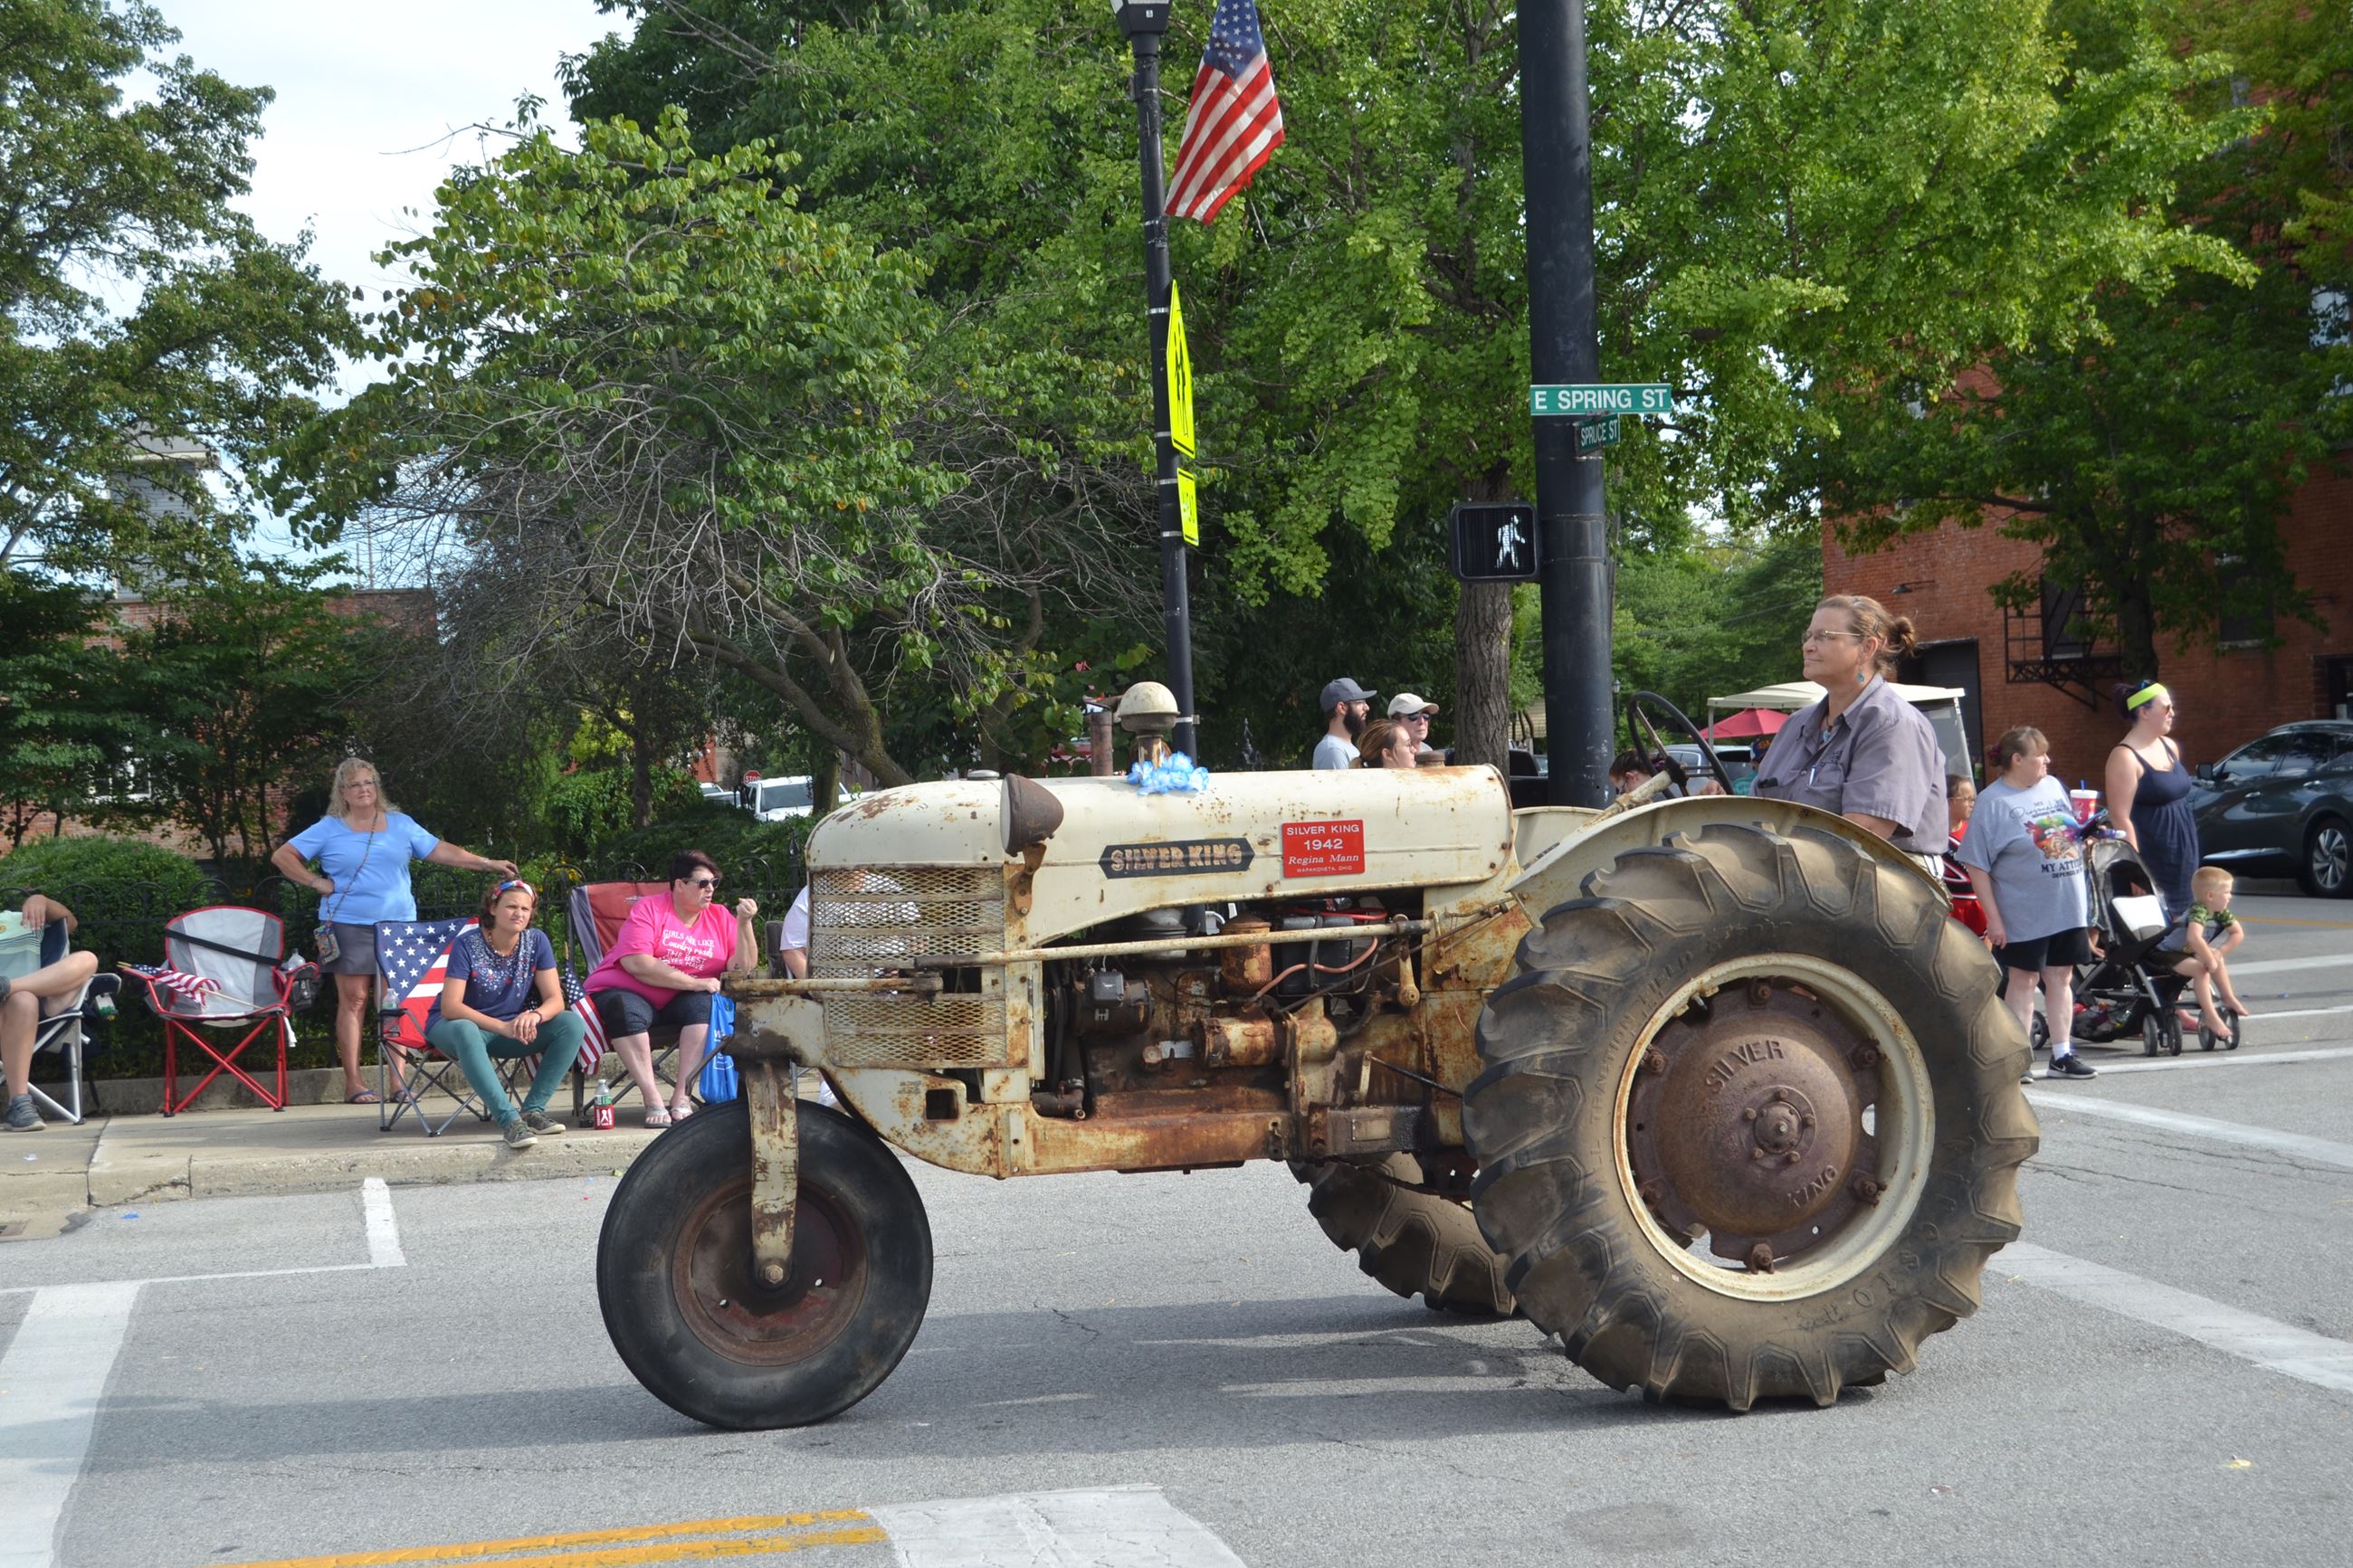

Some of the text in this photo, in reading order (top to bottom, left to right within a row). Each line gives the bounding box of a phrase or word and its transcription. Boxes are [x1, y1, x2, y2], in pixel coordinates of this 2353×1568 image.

[1534, 388, 1667, 409] E SPRING ST
[1580, 419, 1618, 446] SPRUCE ST
[1287, 824, 1359, 835] SILVER KING
[1304, 838, 1343, 851] 1942
[1110, 843, 1243, 871] SILVER KING
[1289, 854, 1359, 866] Regina Mann
[2041, 862, 2055, 873] MY
[662, 928, 684, 939] GIRLS
[698, 938, 715, 947] LIKE
[1706, 1041, 1785, 1093] SILVER
[1787, 1164, 1838, 1208] KING
